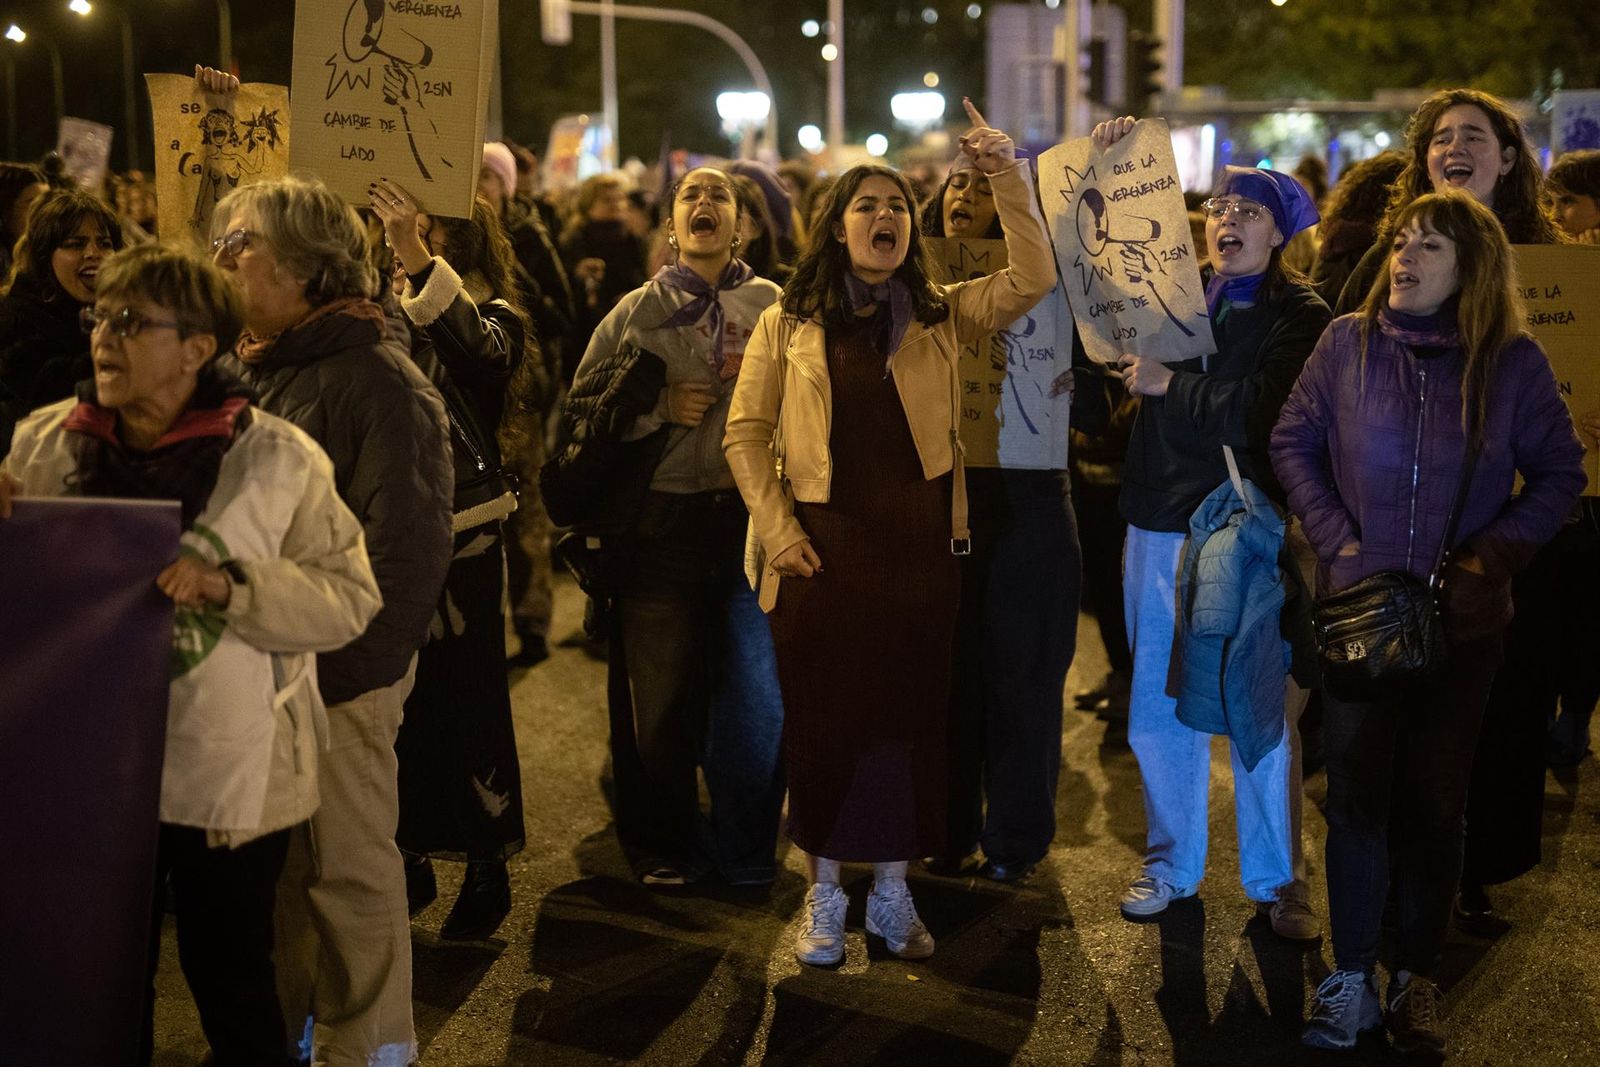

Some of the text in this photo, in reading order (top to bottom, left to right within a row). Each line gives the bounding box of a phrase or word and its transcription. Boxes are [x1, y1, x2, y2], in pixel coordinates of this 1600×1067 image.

[424, 81, 452, 97] 25N
[181, 103, 201, 114] se
[324, 111, 396, 132] CAMBIE DE
[341, 145, 375, 161] LADO
[1113, 153, 1157, 176] QUE LA
[1106, 175, 1176, 202] VERGÜENZA
[1161, 244, 1188, 262] 25N
[1545, 284, 1562, 299] LA
[1089, 295, 1149, 318] CAMBIE DE
[1112, 327, 1137, 340] LADO
[1028, 348, 1055, 361] 25N
